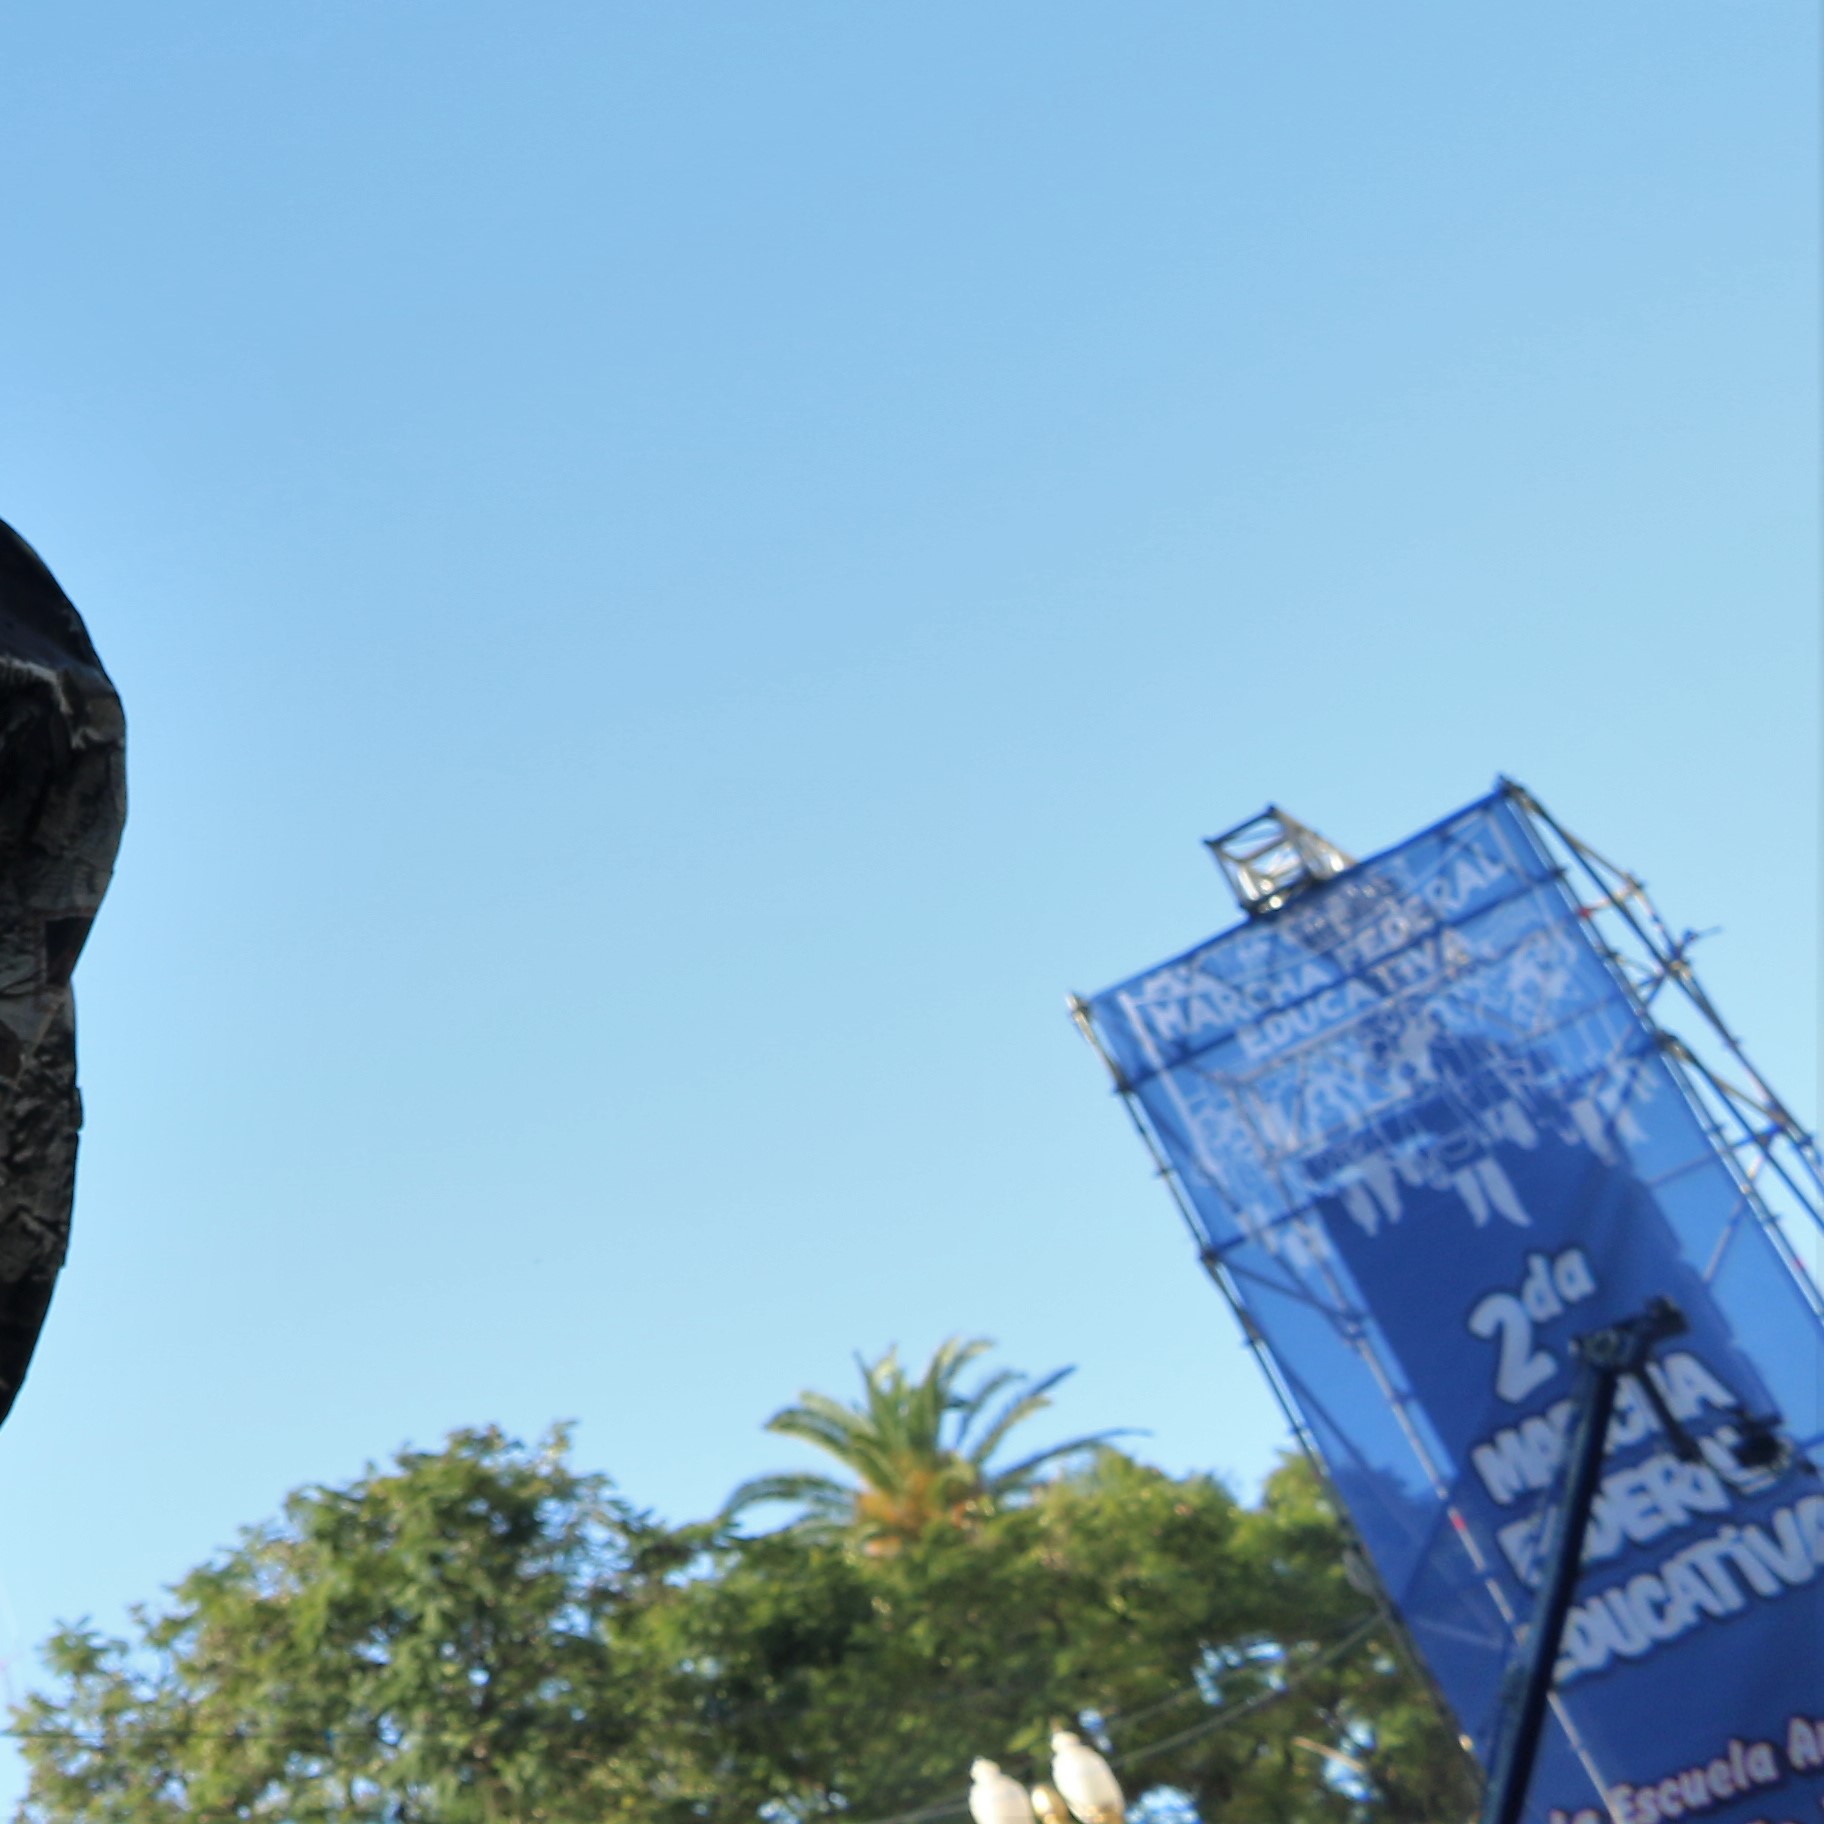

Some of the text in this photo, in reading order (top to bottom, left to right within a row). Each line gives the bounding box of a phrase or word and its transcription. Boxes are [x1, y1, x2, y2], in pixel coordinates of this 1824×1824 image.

[1153, 963, 1333, 1042] MARCHA
[1337, 840, 1508, 969] FEDERAL
[1236, 927, 1472, 1061] EDUCATIVA
[1468, 1248, 1596, 1405] 2da
[1787, 1717, 1824, 1771] A
